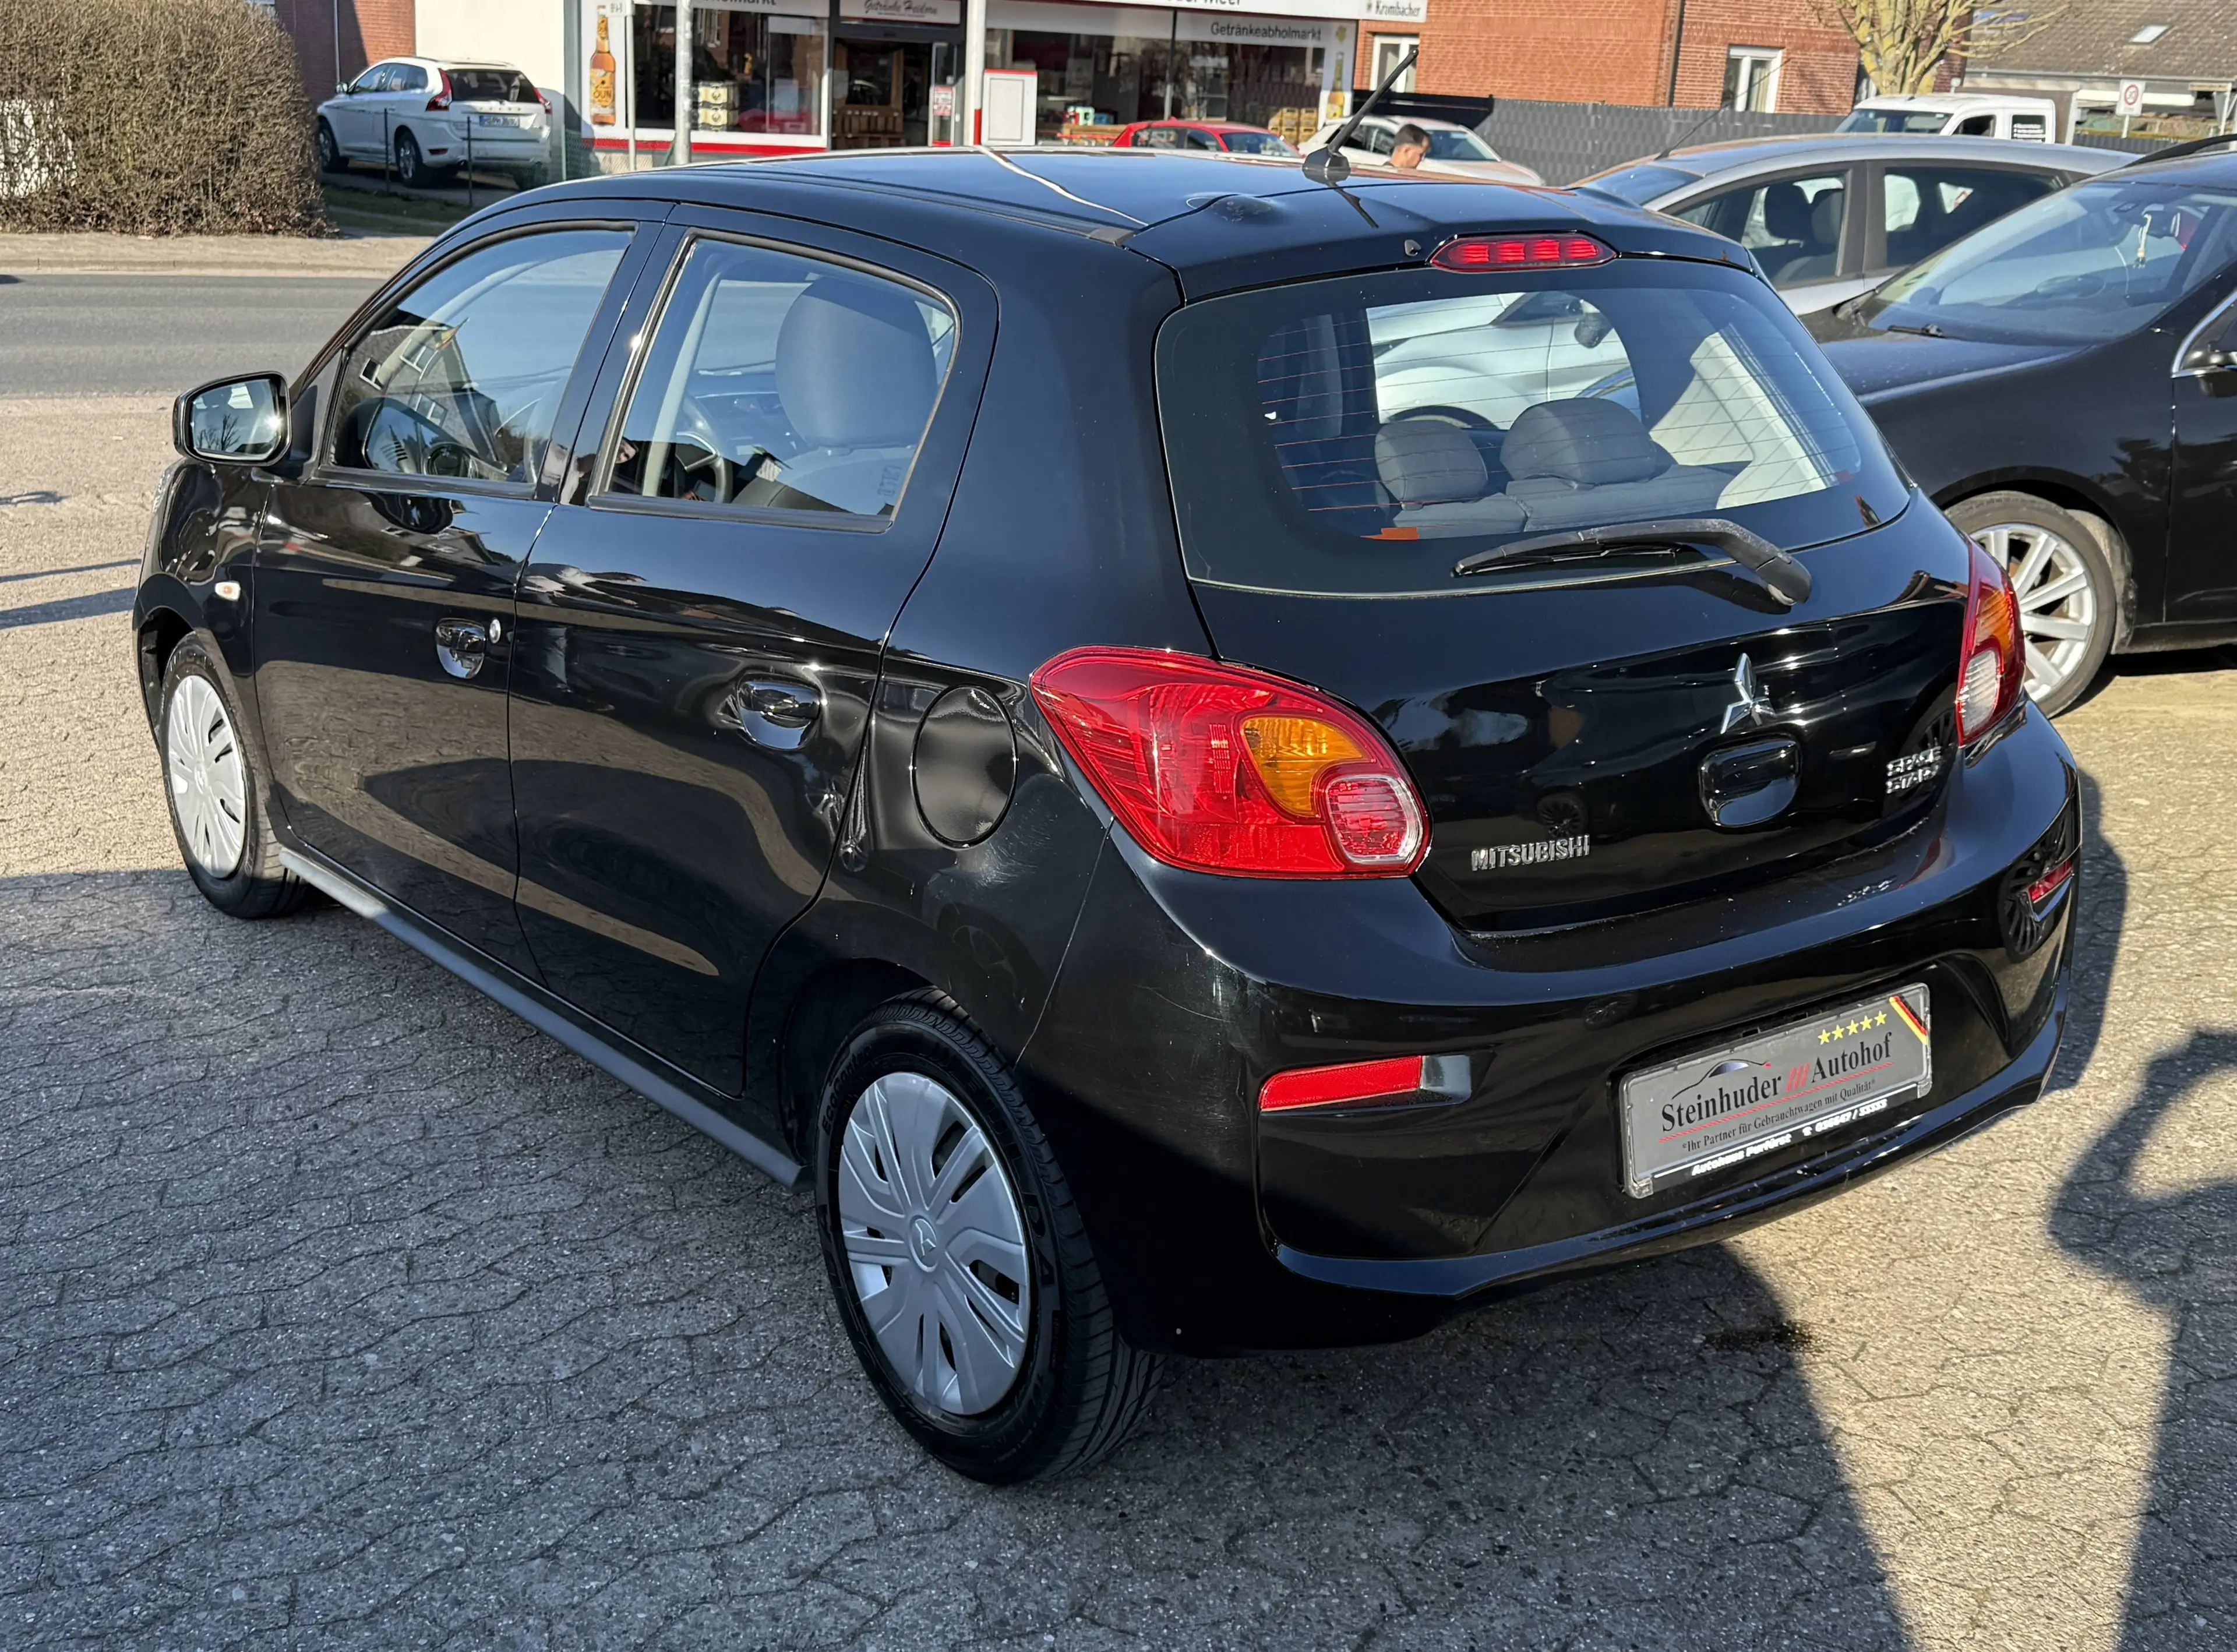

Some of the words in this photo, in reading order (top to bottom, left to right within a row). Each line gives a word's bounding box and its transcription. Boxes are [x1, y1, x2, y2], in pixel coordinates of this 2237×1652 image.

[1210, 21, 1322, 41] Getränkeabholmarkt
[1887, 746, 1941, 776] SPACE
[1886, 764, 1939, 793] STAR
[1471, 834, 1590, 871] MITSUBISHI
[1661, 1076, 1782, 1132] Steinhuder
[1811, 1032, 1892, 1083] Autohof
[1703, 1128, 1737, 1146] Partner
[1739, 1123, 1752, 1135] für
[1753, 1099, 1823, 1128] Gebrauchtwagen
[1825, 1092, 1839, 1105] mit
